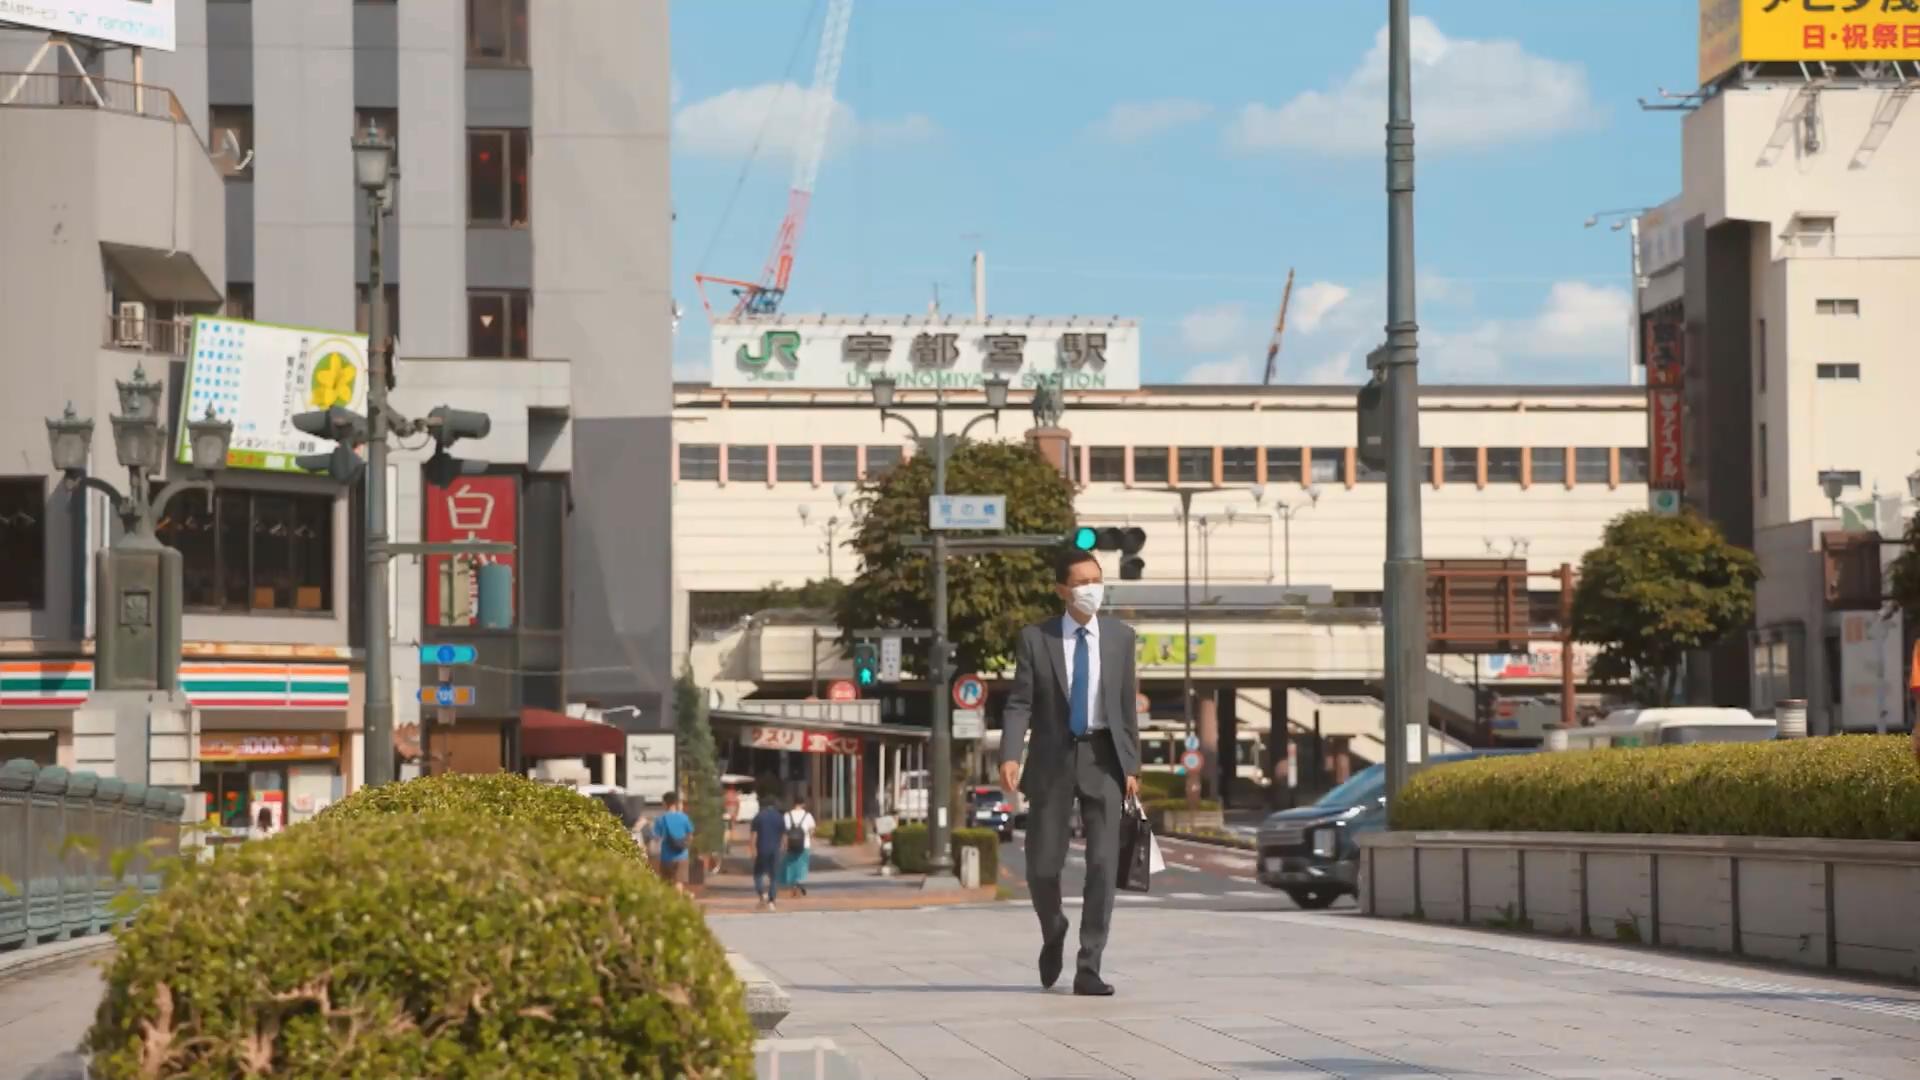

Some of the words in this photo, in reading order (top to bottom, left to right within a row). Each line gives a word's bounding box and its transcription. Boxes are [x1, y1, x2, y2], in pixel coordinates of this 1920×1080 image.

[741, 331, 800, 364] JR
[846, 331, 1108, 367] 宇都宮駅
